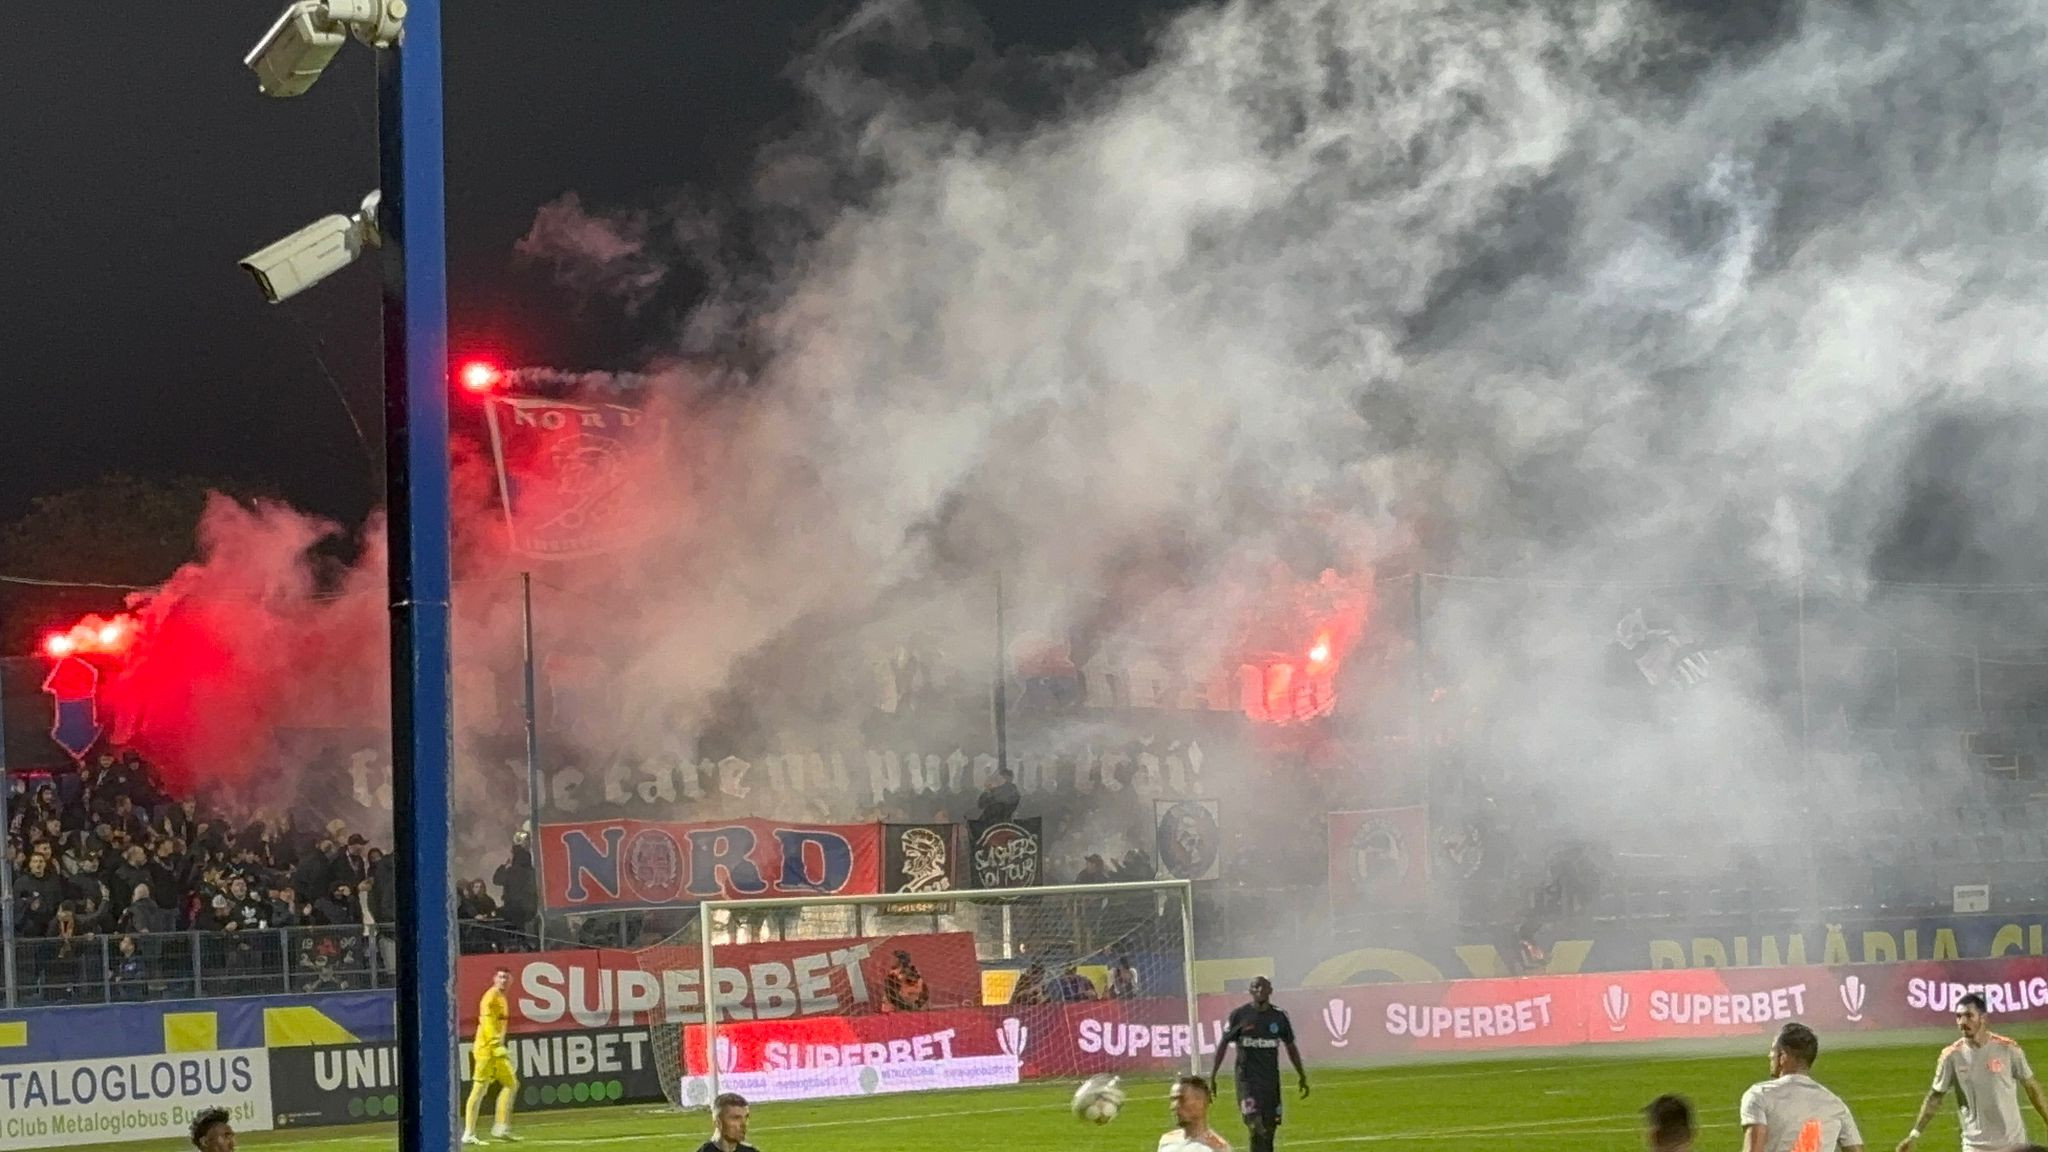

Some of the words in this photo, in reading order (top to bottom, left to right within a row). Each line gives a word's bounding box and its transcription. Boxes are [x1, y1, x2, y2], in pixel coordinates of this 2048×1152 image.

[519, 943, 871, 1027] SUPERBET
[1649, 983, 1807, 1025] SUPERBET
[1386, 993, 1552, 1039] SUPERBET
[763, 1029, 955, 1072] SUPERBET
[7, 1111, 48, 1139] Club
[52, 1106, 169, 1136] Metaloglobus
